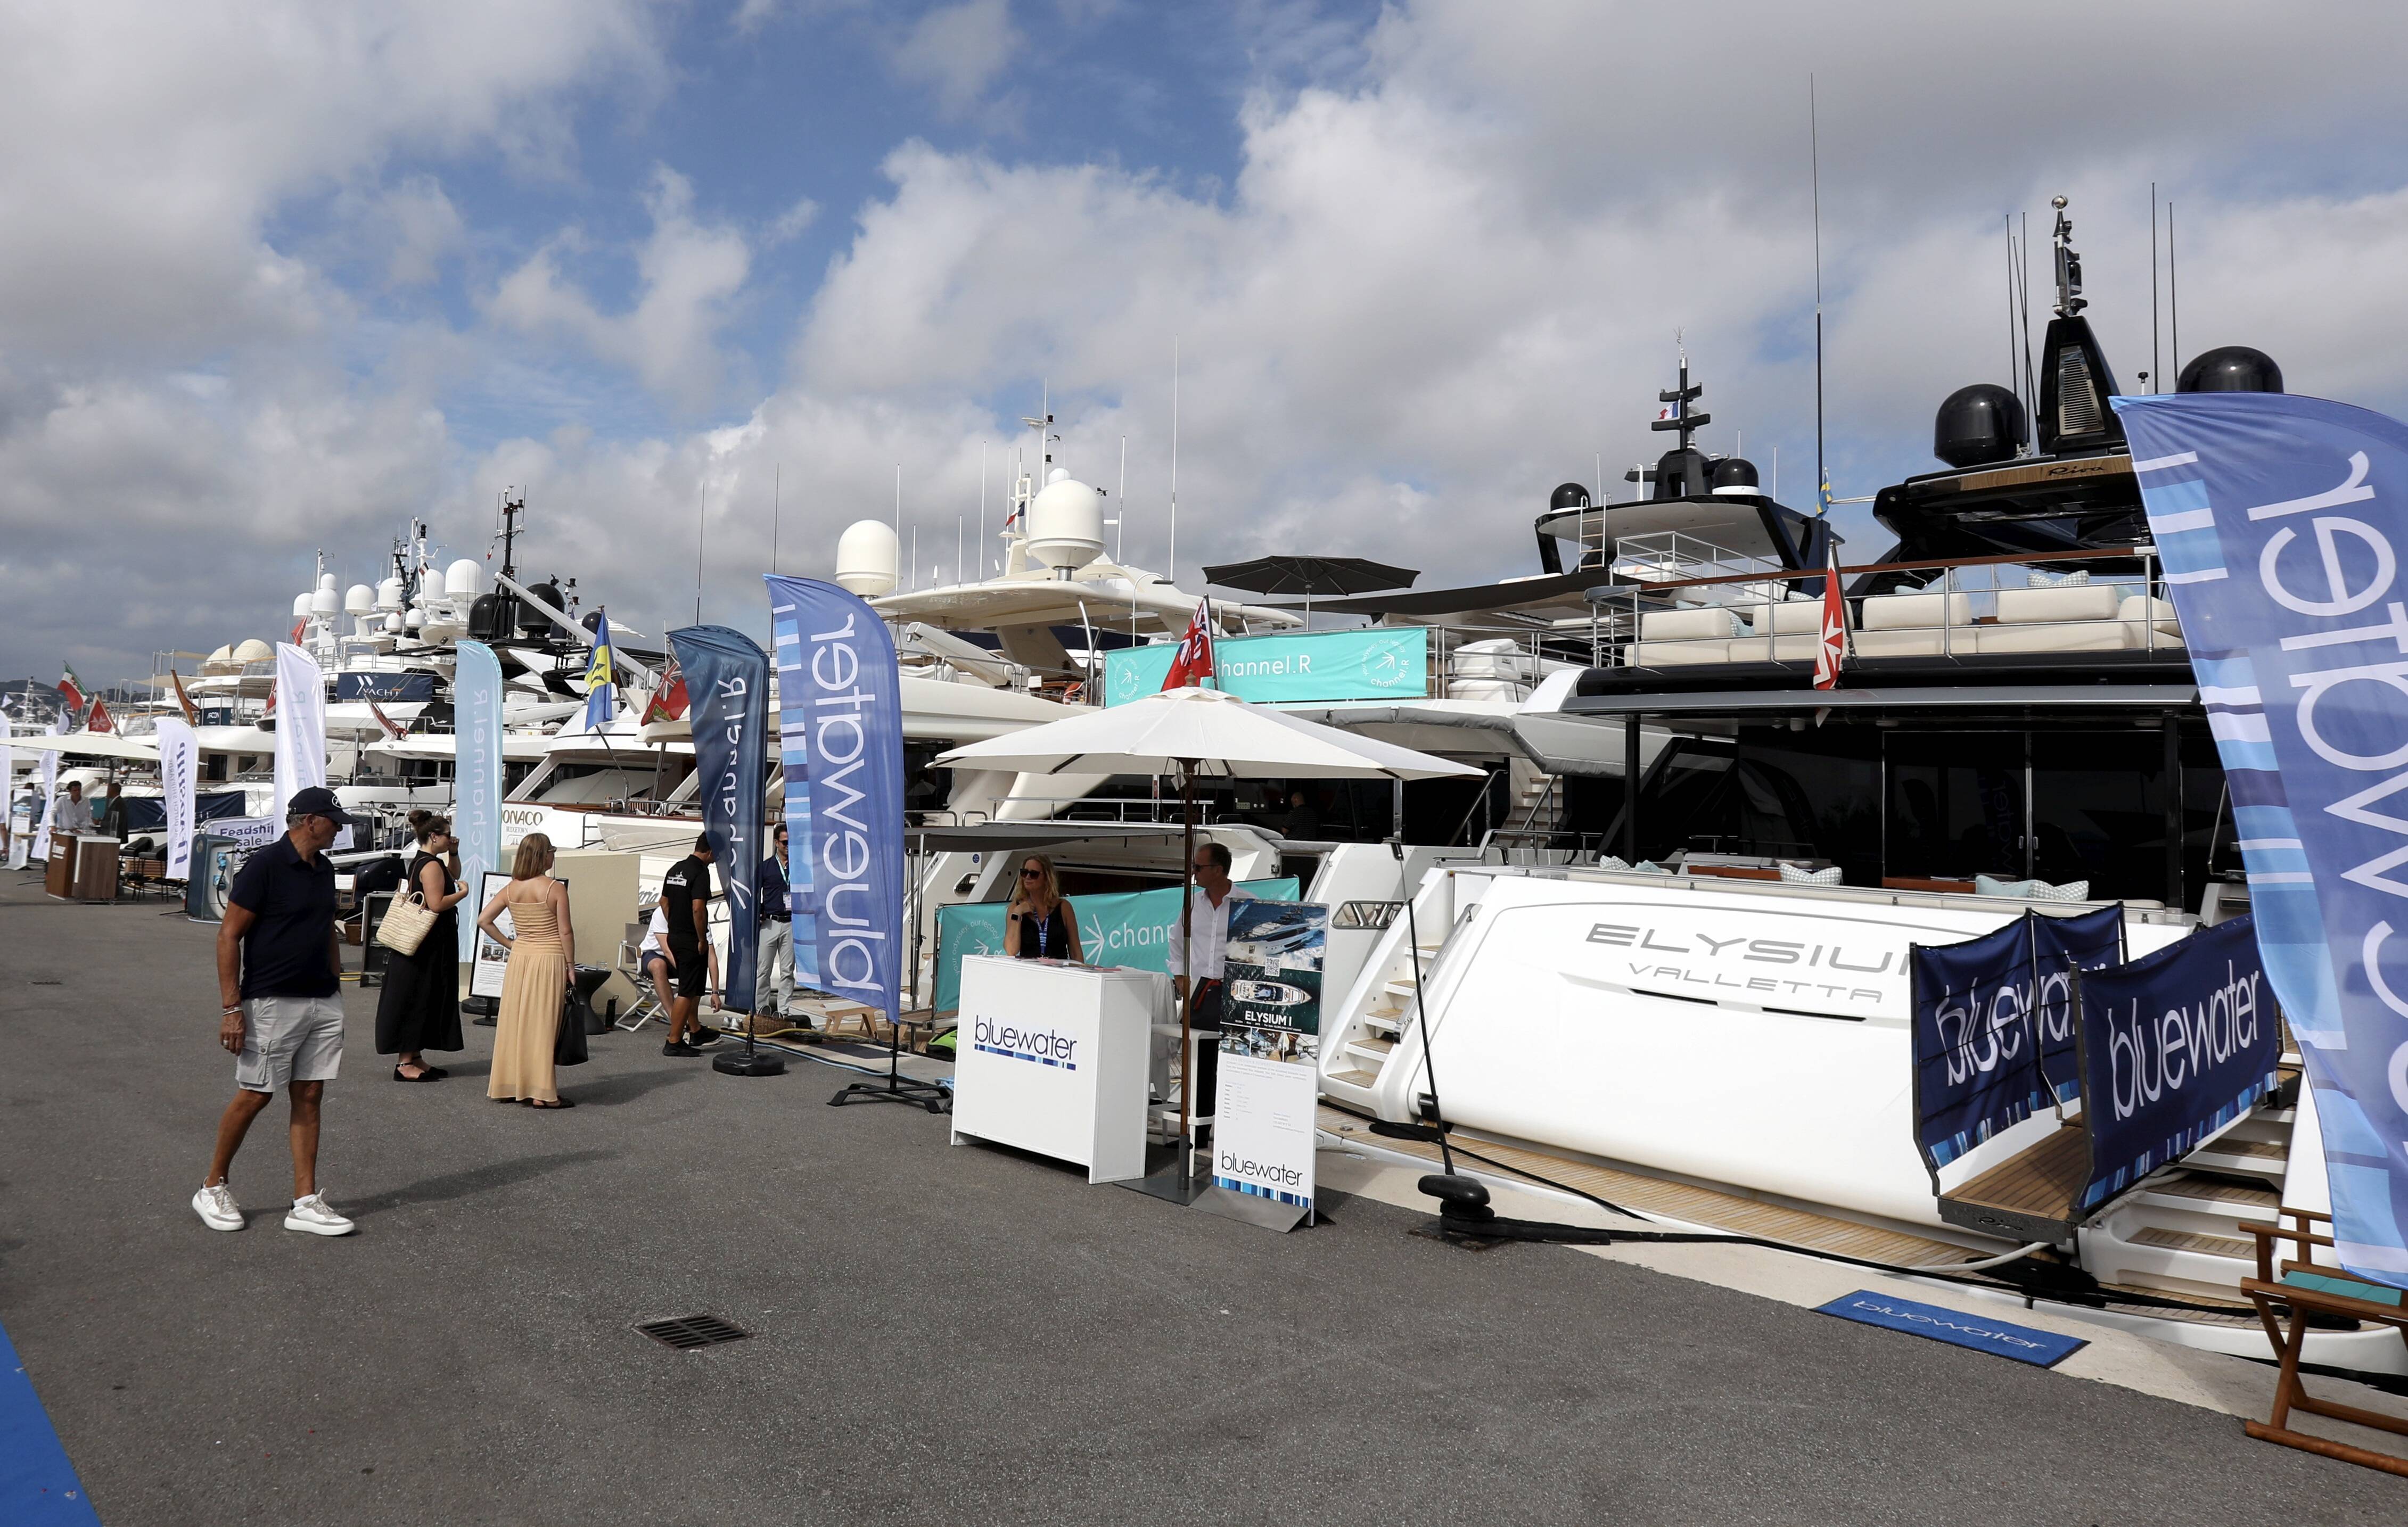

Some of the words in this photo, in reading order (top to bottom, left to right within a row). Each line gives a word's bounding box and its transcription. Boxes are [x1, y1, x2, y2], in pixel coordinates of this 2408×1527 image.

[2048, 466, 2105, 476] Riva
[1216, 655, 1312, 677] hannel.R
[1370, 659, 1410, 688] channel.R
[220, 824, 274, 837] Feadshi
[501, 810, 543, 826] ONACO
[982, 919, 1000, 939] legacy
[1585, 923, 1910, 976] ELYSIU
[1629, 962, 1883, 1003] VALLETTA
[1245, 1010, 1287, 1026] ELYSIUM
[1288, 1016, 1292, 1027] I
[975, 1014, 1078, 1060] bluewater
[2107, 959, 2260, 1121] bluewater
[1221, 1150, 1303, 1186] bluewater
[1853, 1300, 2048, 1349] bluewater
